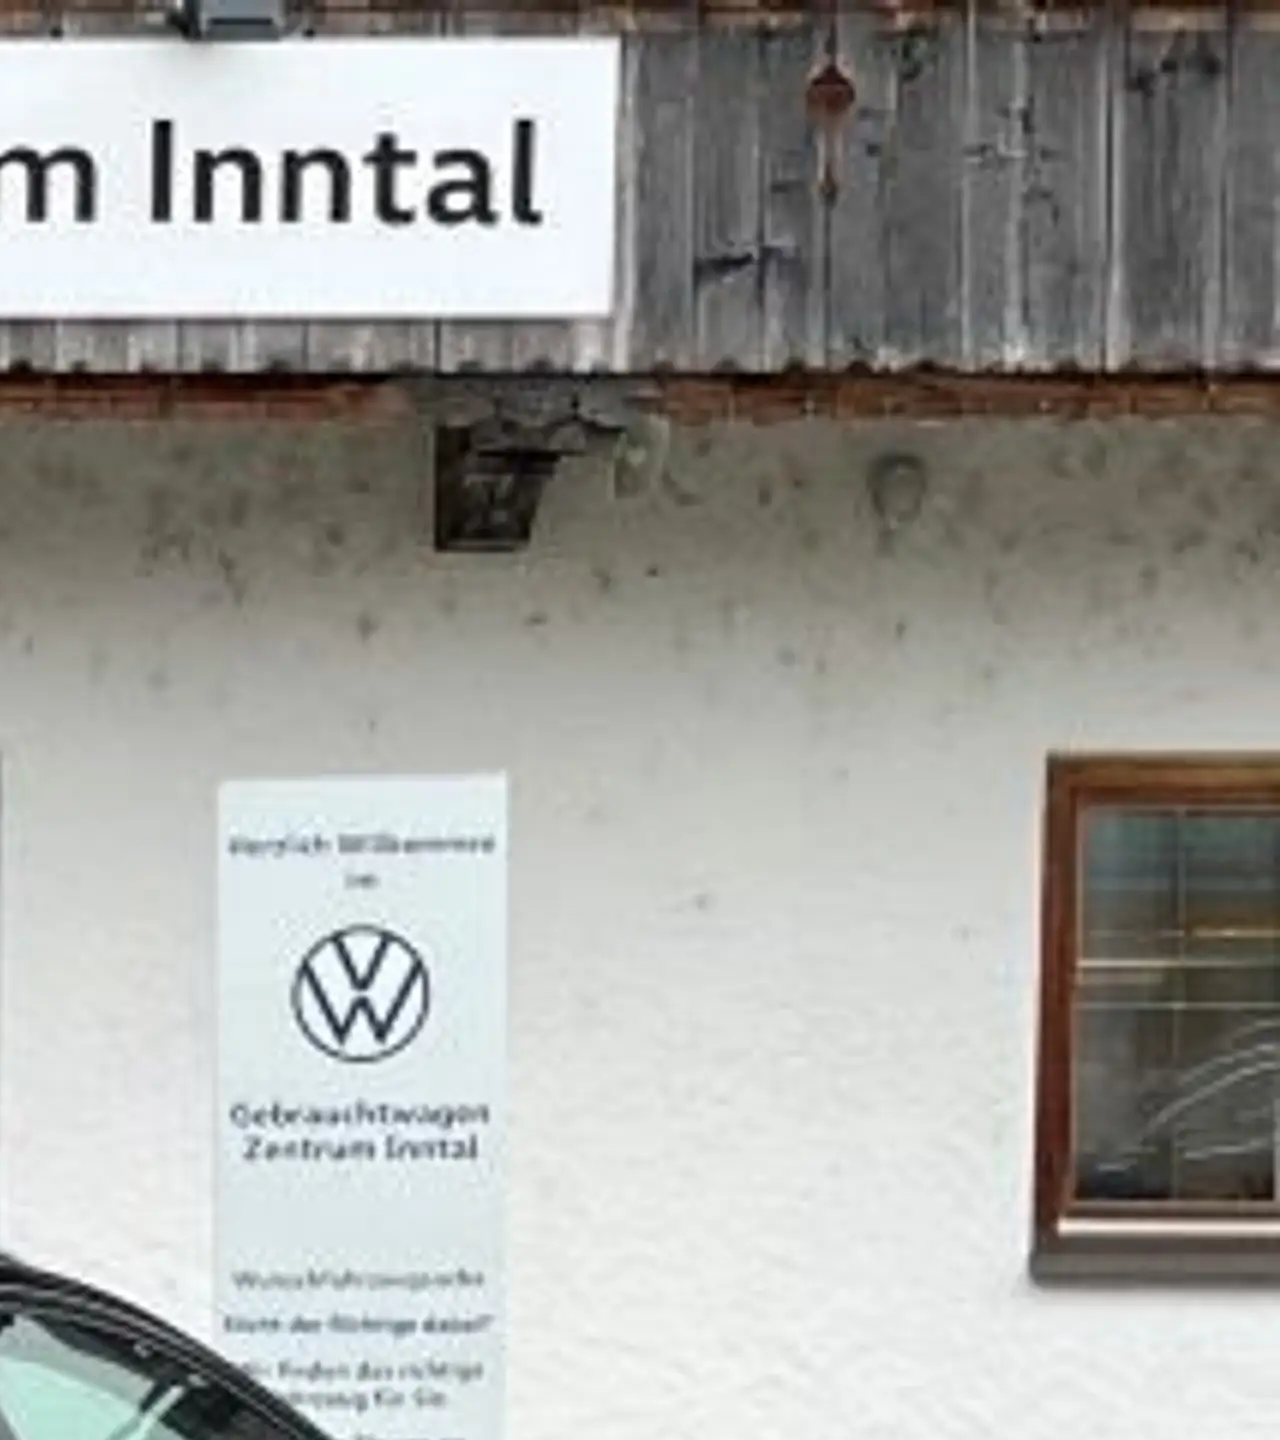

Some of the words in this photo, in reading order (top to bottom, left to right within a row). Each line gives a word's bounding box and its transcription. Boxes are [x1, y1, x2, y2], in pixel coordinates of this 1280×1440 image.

[150, 118, 543, 226] Inntal
[337, 833, 496, 855] Willkommen
[228, 1098, 491, 1131] Gebrauchtwagen
[242, 1134, 377, 1162] Zentrum
[384, 1133, 479, 1162] Inntal
